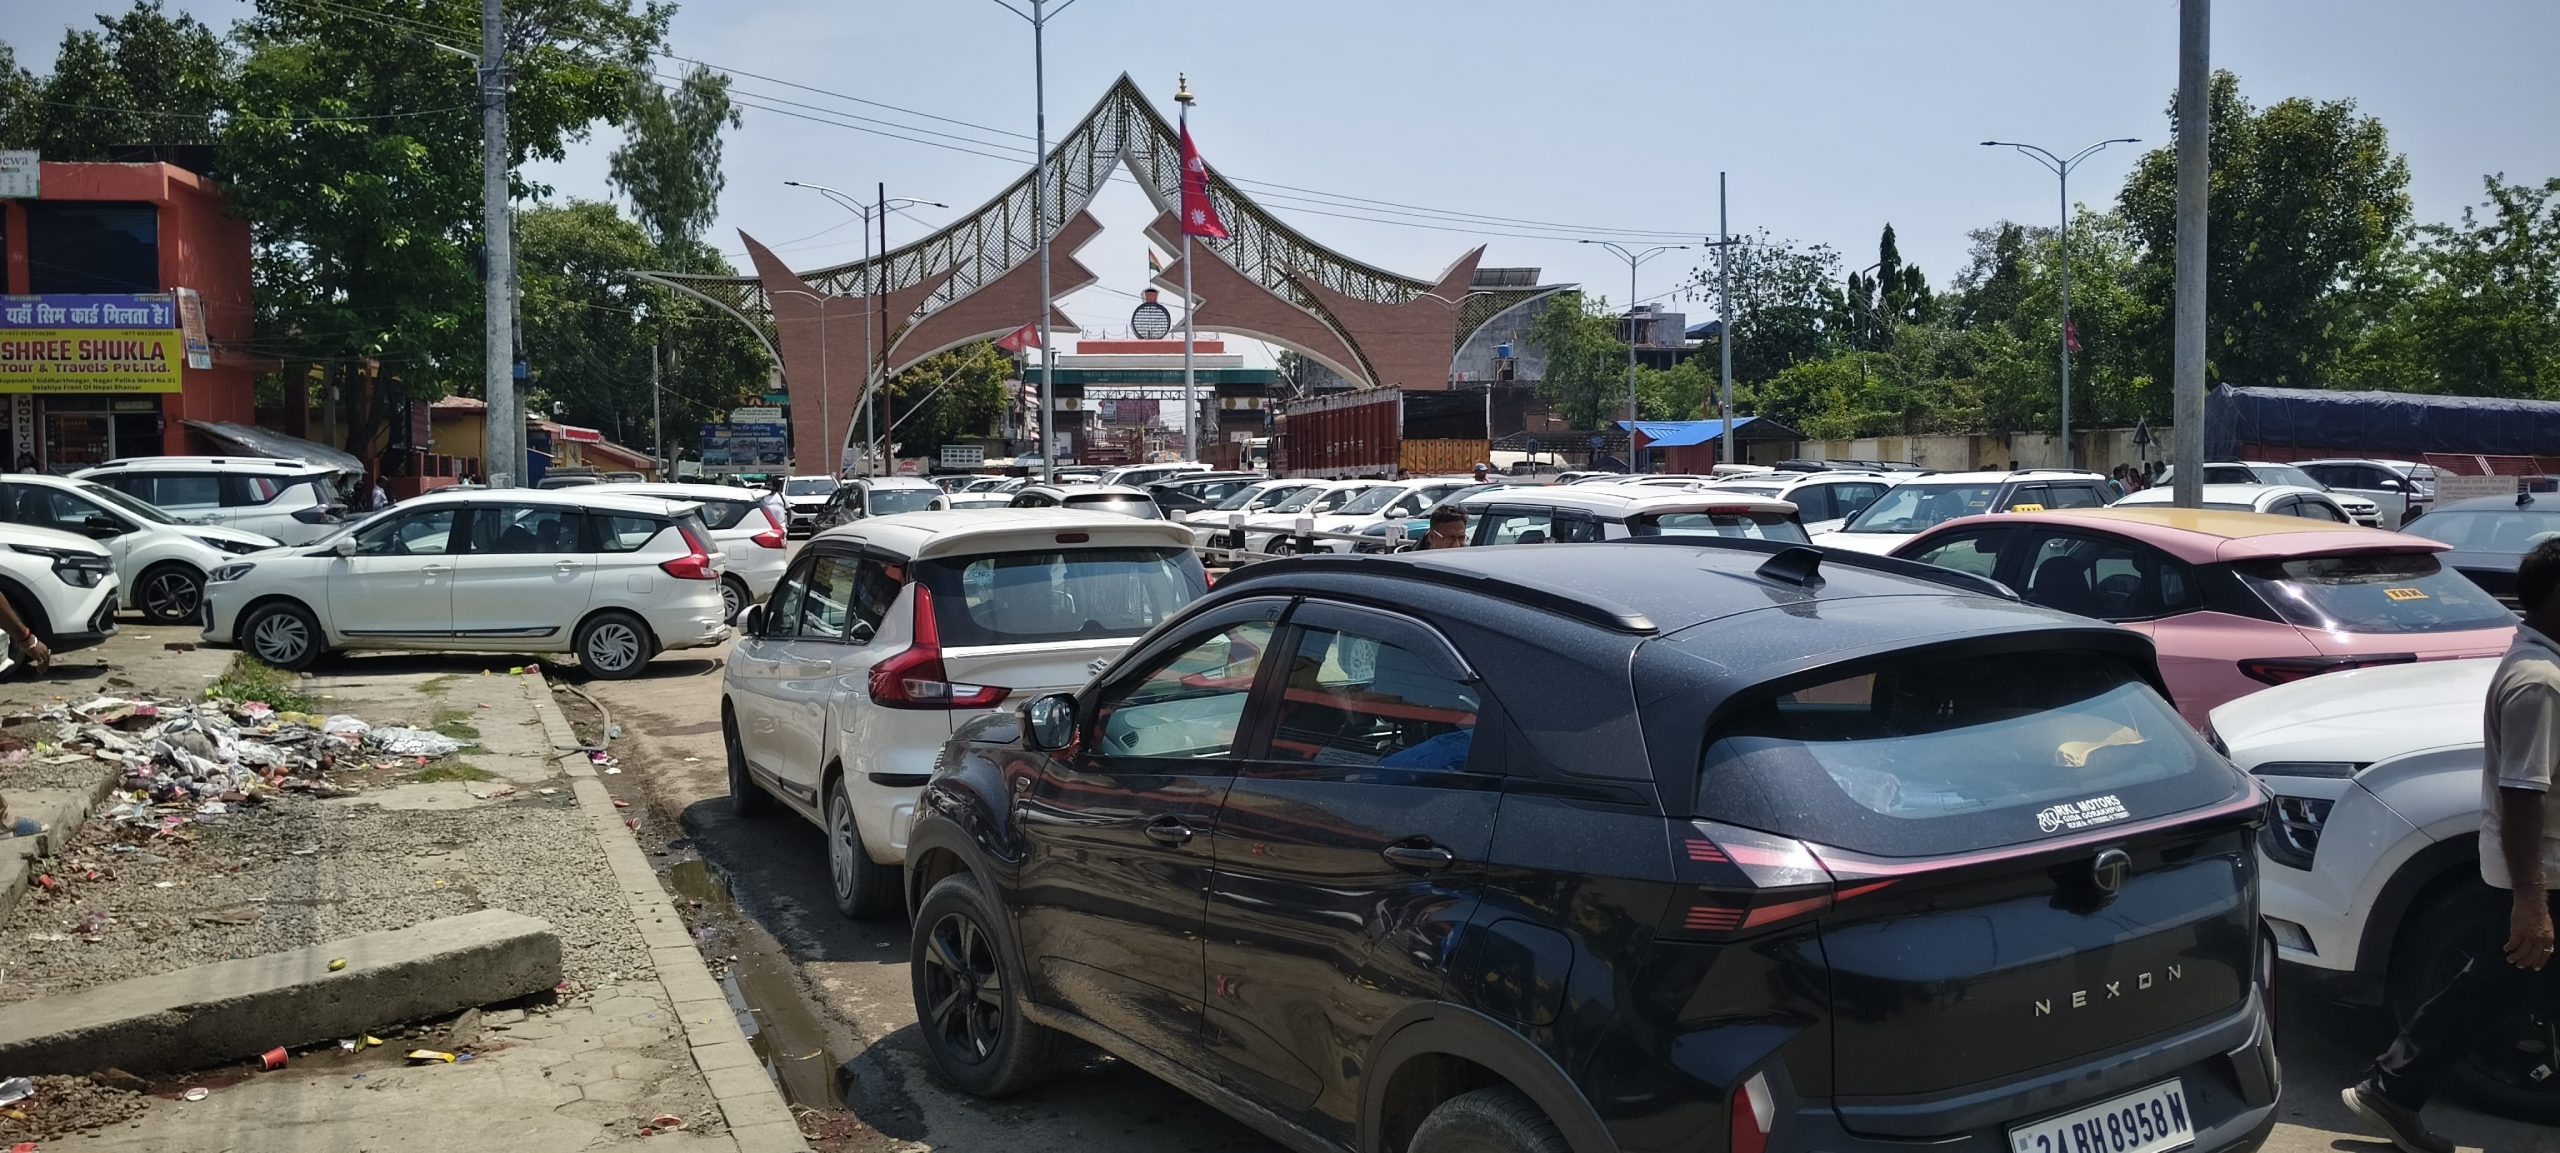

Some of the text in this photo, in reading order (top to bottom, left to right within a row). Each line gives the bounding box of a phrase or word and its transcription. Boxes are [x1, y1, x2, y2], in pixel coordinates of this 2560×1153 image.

[5, 303, 33, 324] यहाँ
[36, 303, 66, 324] सिम
[69, 303, 99, 324] कार्ड
[103, 303, 149, 325] मिलता
[1, 340, 166, 361] SHREE SHUKLA
[0, 363, 33, 373] Tour
[39, 363, 48, 373] &
[55, 363, 108, 373] Travels
[0, 377, 35, 385] upandehi
[93, 384, 113, 392] Nepal
[2387, 589, 2423, 598] TAXI
[2053, 795, 2121, 816] RKL MOTORS
[2081, 805, 2127, 820] GORAKHPUR
[2035, 964, 2182, 1017] NEXON
